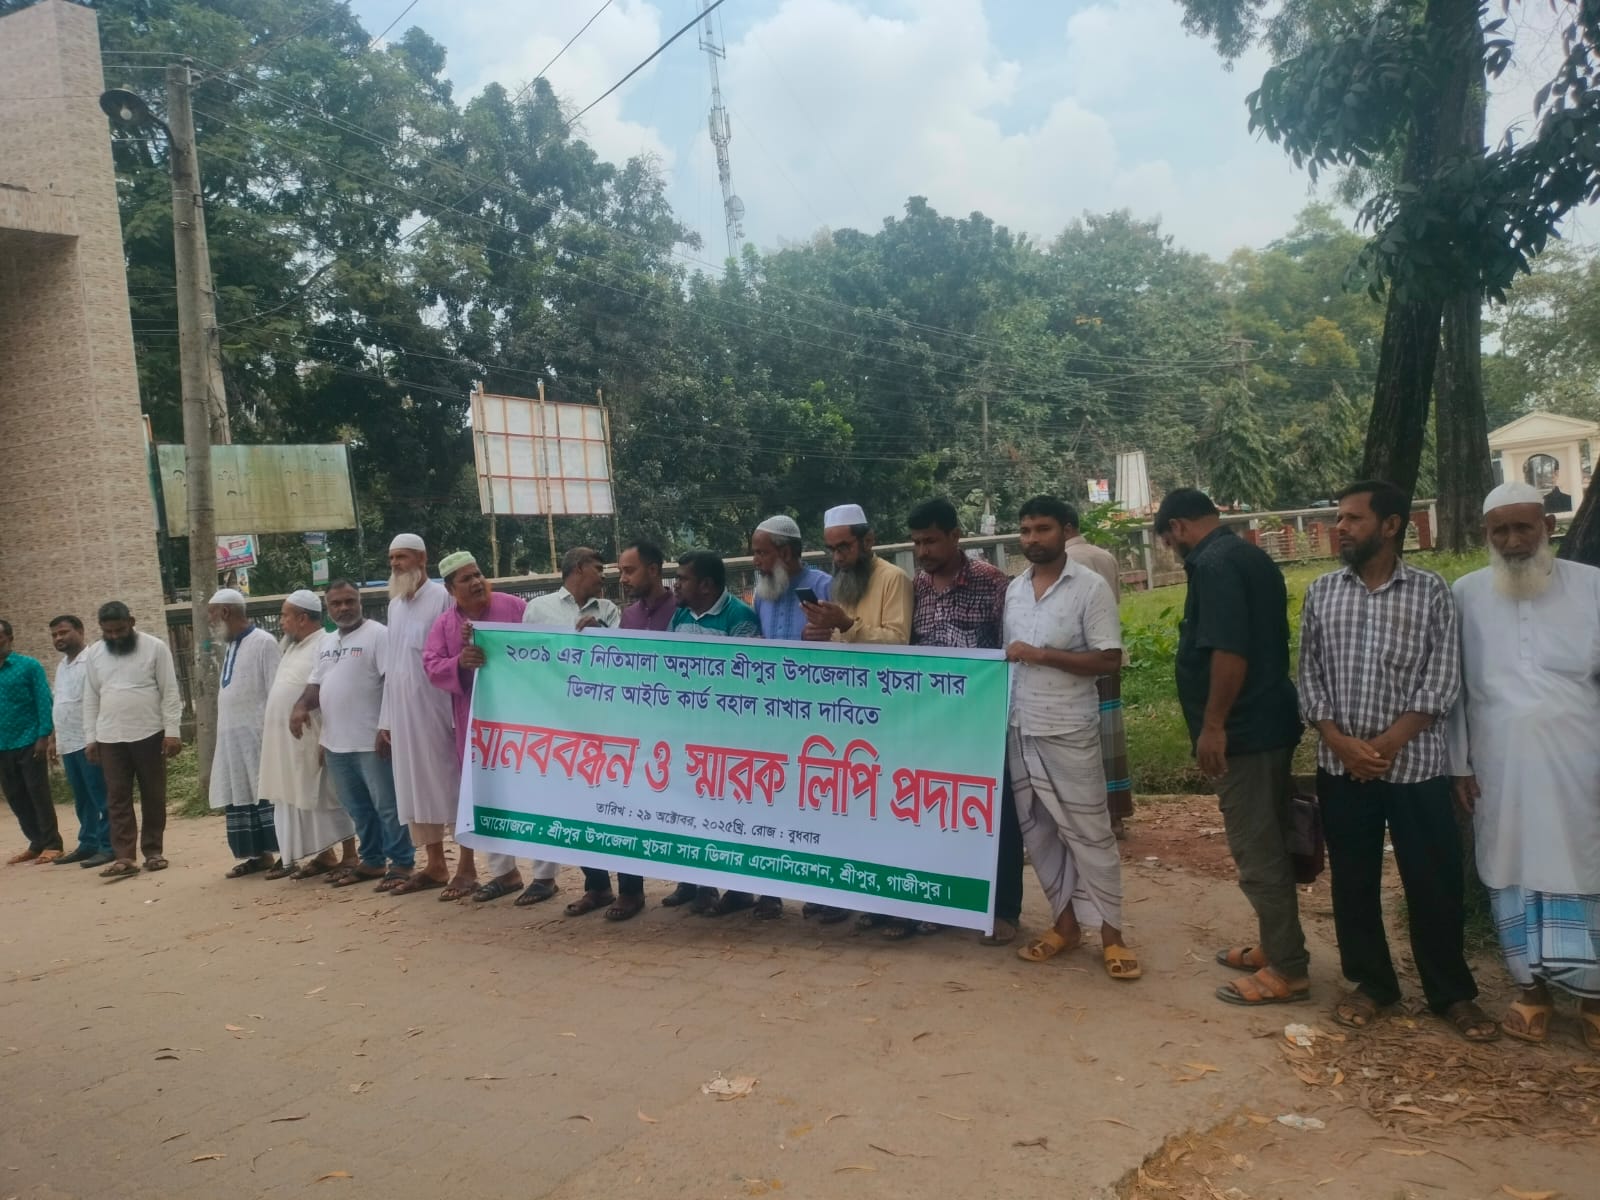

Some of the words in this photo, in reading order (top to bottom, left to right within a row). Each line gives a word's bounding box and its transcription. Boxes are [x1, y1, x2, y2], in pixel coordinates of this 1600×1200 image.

[506, 644, 551, 663] ২০০৯
[556, 648, 586, 665] এর
[590, 645, 659, 673] নিতিমালা
[663, 655, 727, 681] অনুসারে
[731, 652, 777, 686] শ্রীপুর
[783, 656, 871, 688] উপজেলার
[876, 667, 923, 697] খুচরা
[928, 672, 968, 696] সার
[566, 674, 617, 703] ডিলার
[621, 680, 673, 707] আইডি
[676, 685, 713, 711] কার্ড
[715, 693, 759, 717] বহাল
[763, 696, 813, 721] রাখার
[817, 697, 882, 726] দাবিতে
[471, 718, 641, 788] মানববন্ধন
[645, 740, 672, 793] ও
[684, 743, 789, 807] স্মারক
[797, 734, 883, 820] লিপি
[889, 766, 997, 837] প্রদান
[596, 802, 627, 818] তারিখ
[636, 807, 652, 822] ২৯
[751, 824, 777, 840] রোজ
[788, 828, 822, 846] বুধবার
[479, 814, 537, 837] আয়োজনে
[547, 820, 581, 845] শ্রীপুর
[584, 826, 639, 852] উপজেলা
[641, 837, 673, 858] খুচরা
[676, 843, 702, 861] সার
[704, 844, 746, 868] ডিলার
[839, 862, 881, 892] শ্রীপুর,
[886, 872, 943, 901] গাজীপুর
